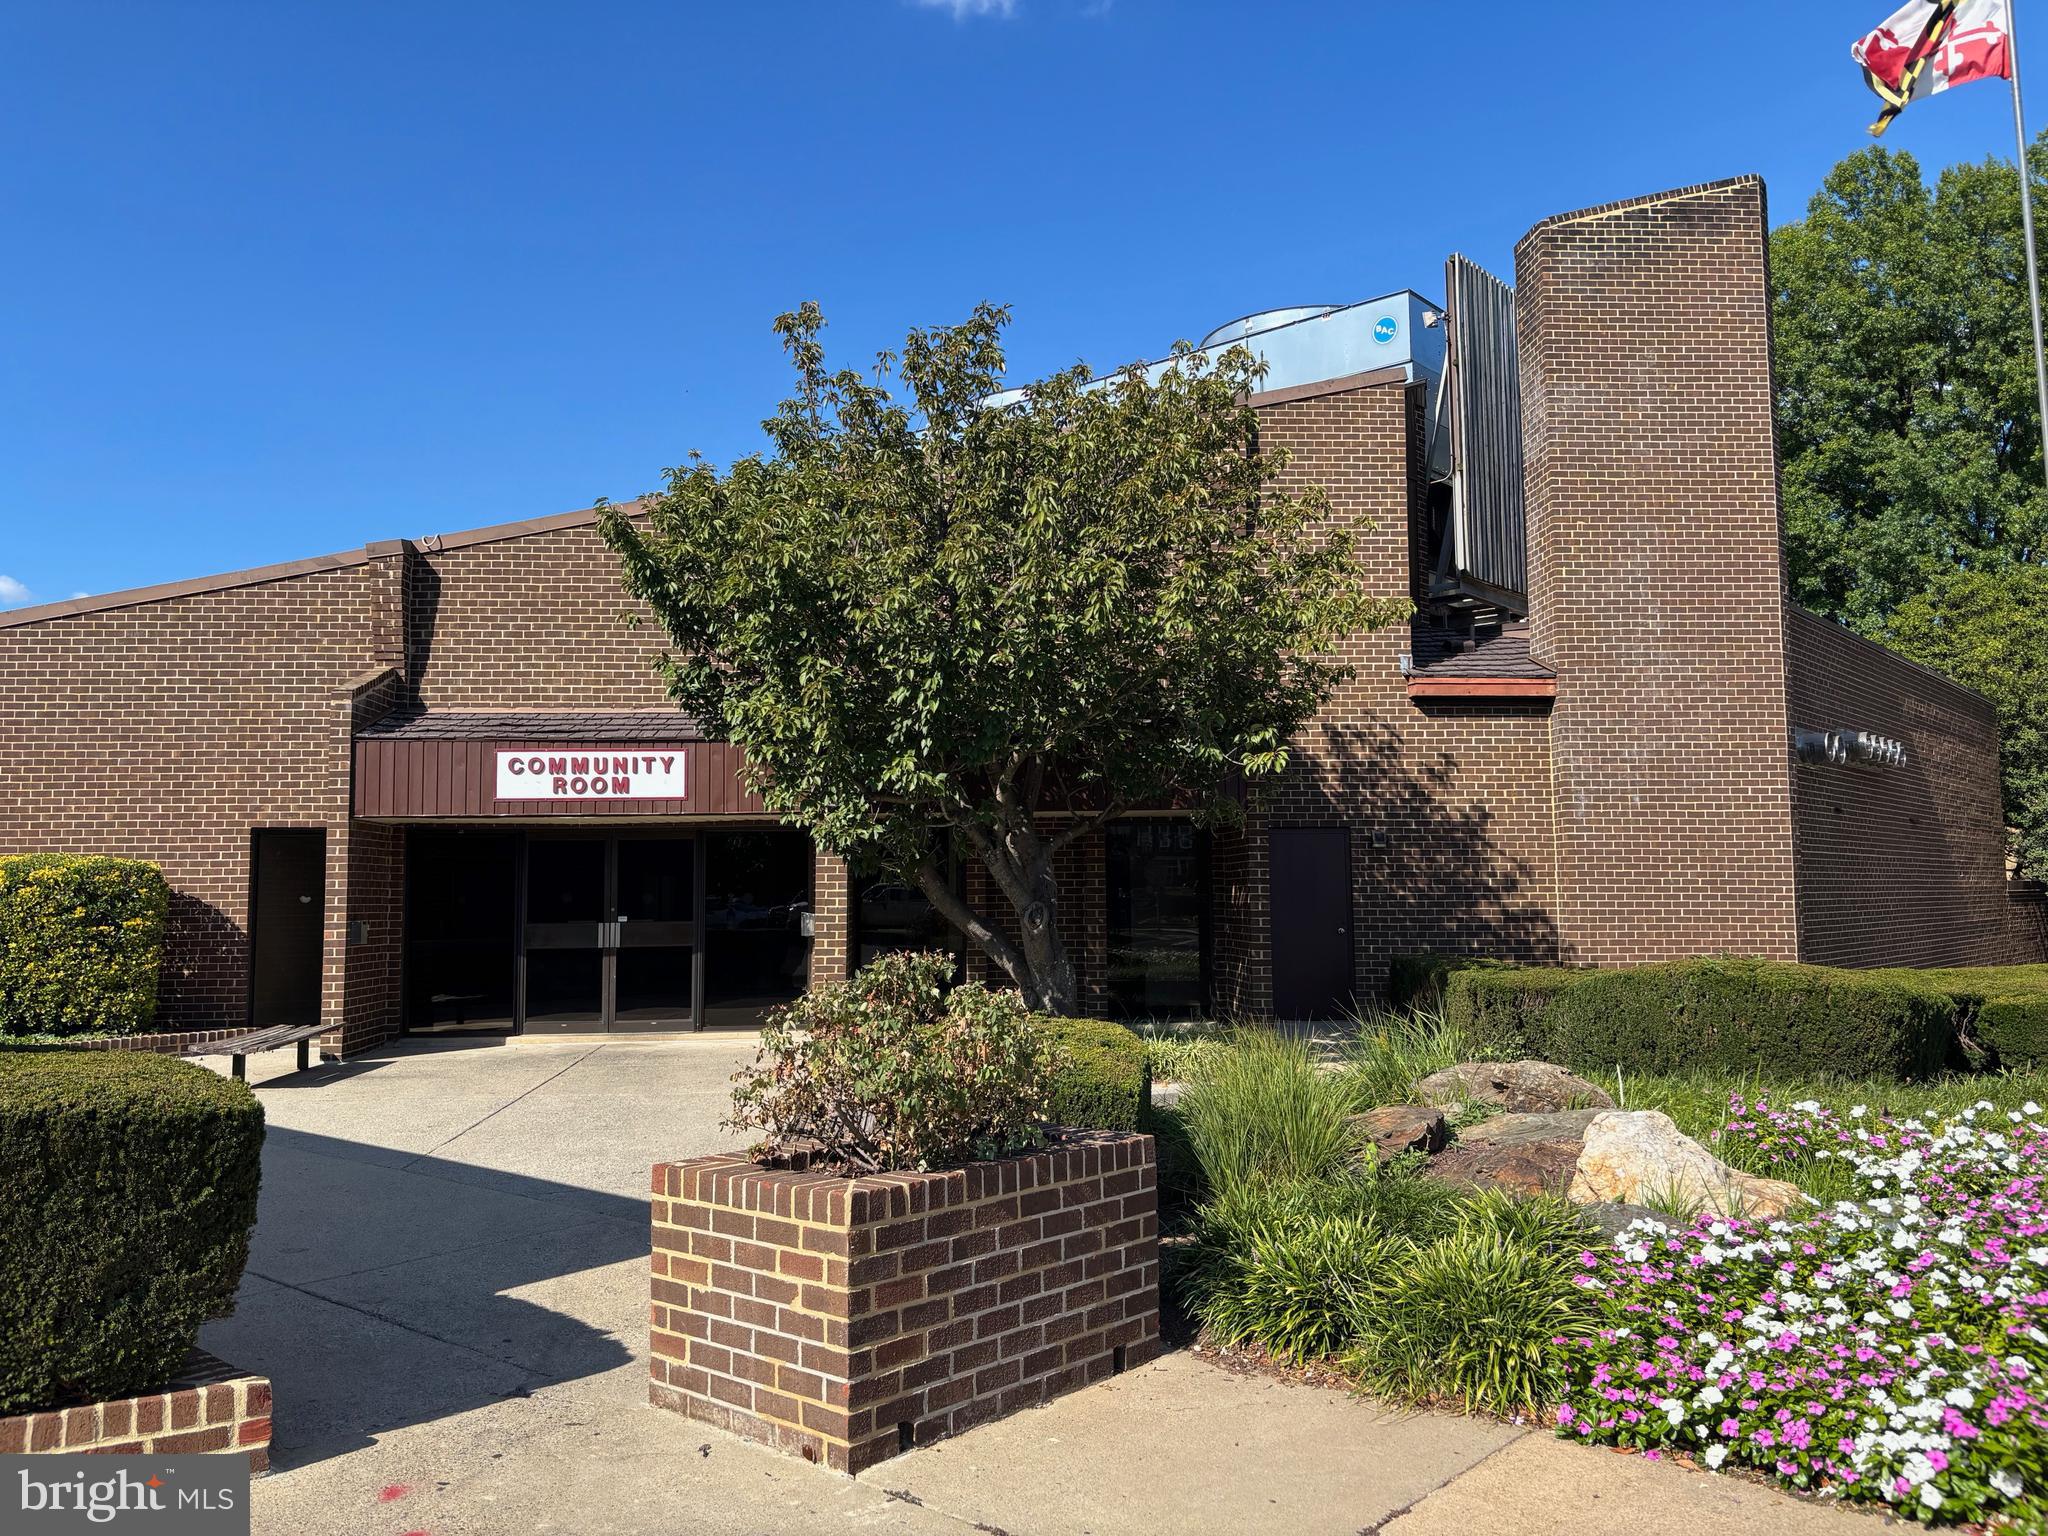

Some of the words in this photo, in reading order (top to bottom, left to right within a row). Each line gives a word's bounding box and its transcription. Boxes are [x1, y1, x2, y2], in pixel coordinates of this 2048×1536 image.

[1375, 325, 1394, 335] BAC
[508, 757, 674, 775] COMMUNITY
[552, 776, 630, 794] ROOM
